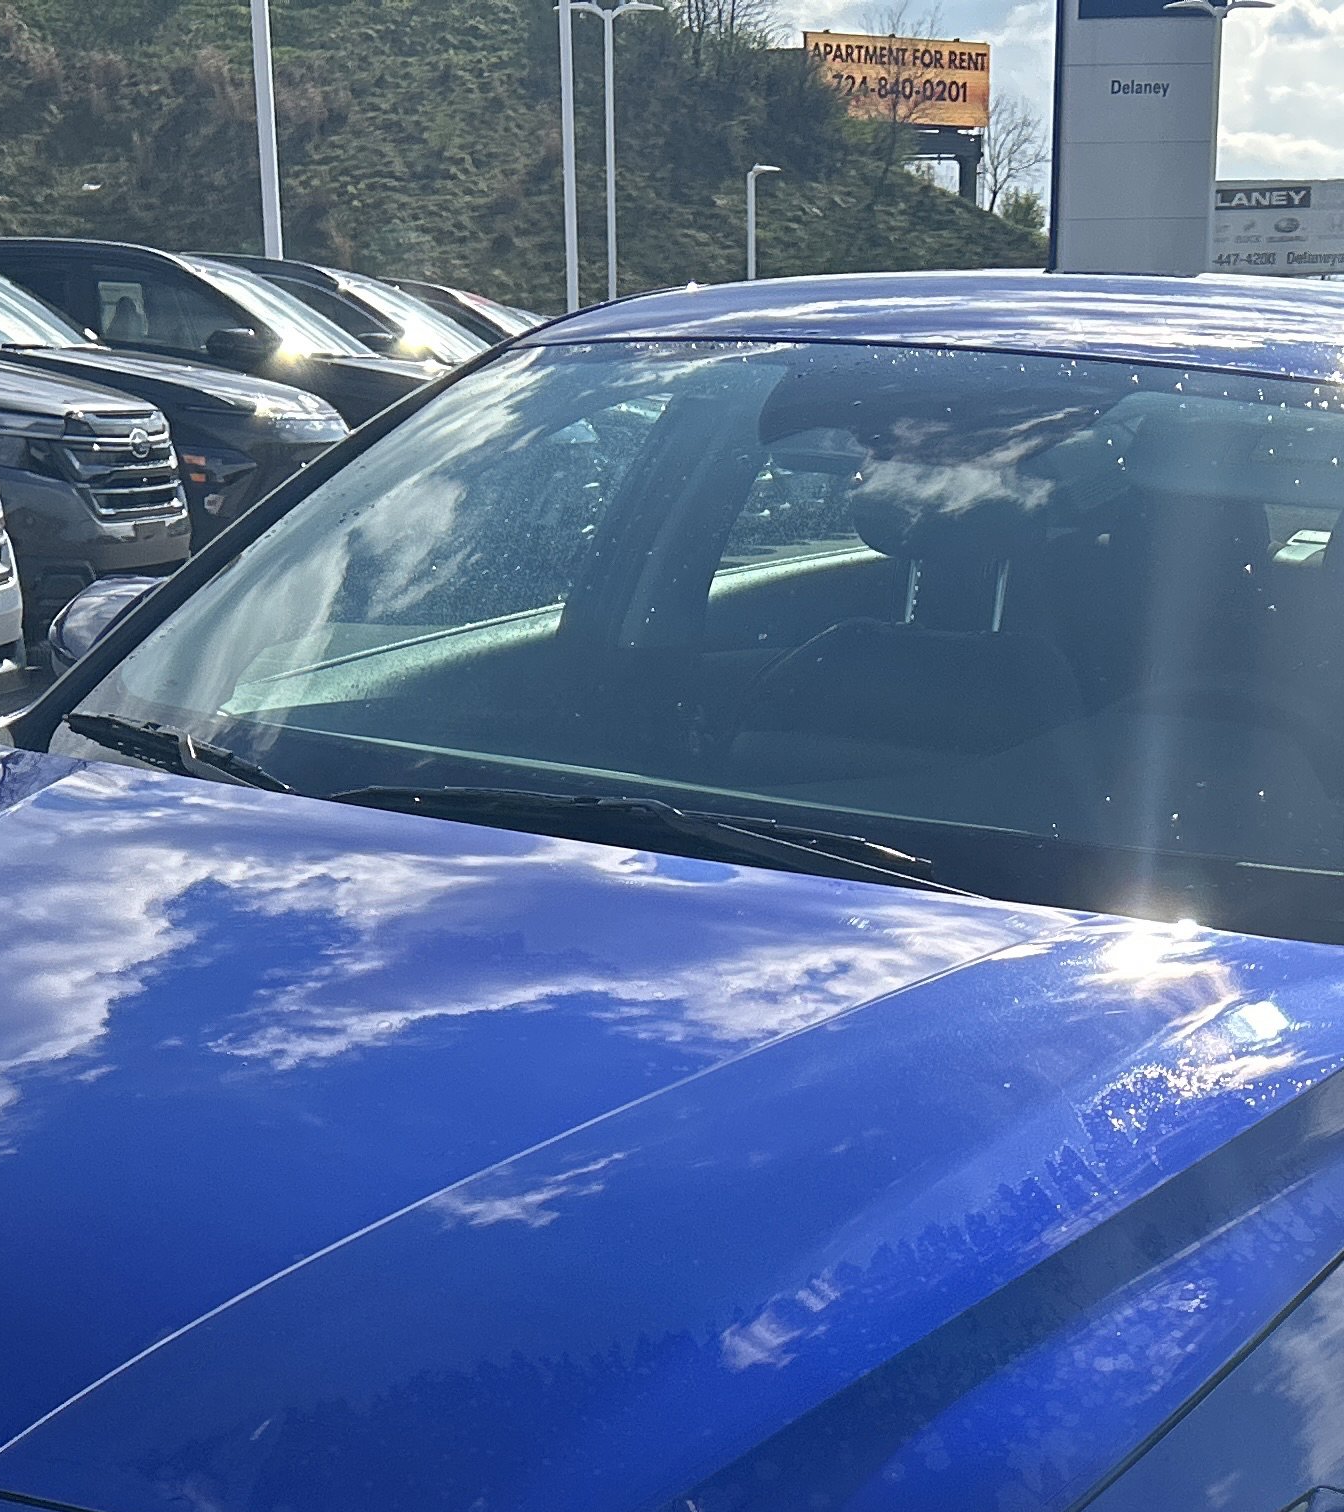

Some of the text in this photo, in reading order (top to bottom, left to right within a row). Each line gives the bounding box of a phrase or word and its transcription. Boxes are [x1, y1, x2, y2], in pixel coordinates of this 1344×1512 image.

[810, 42, 987, 71] APARTMENT FOR RENT
[1110, 79, 1170, 98] Delaney
